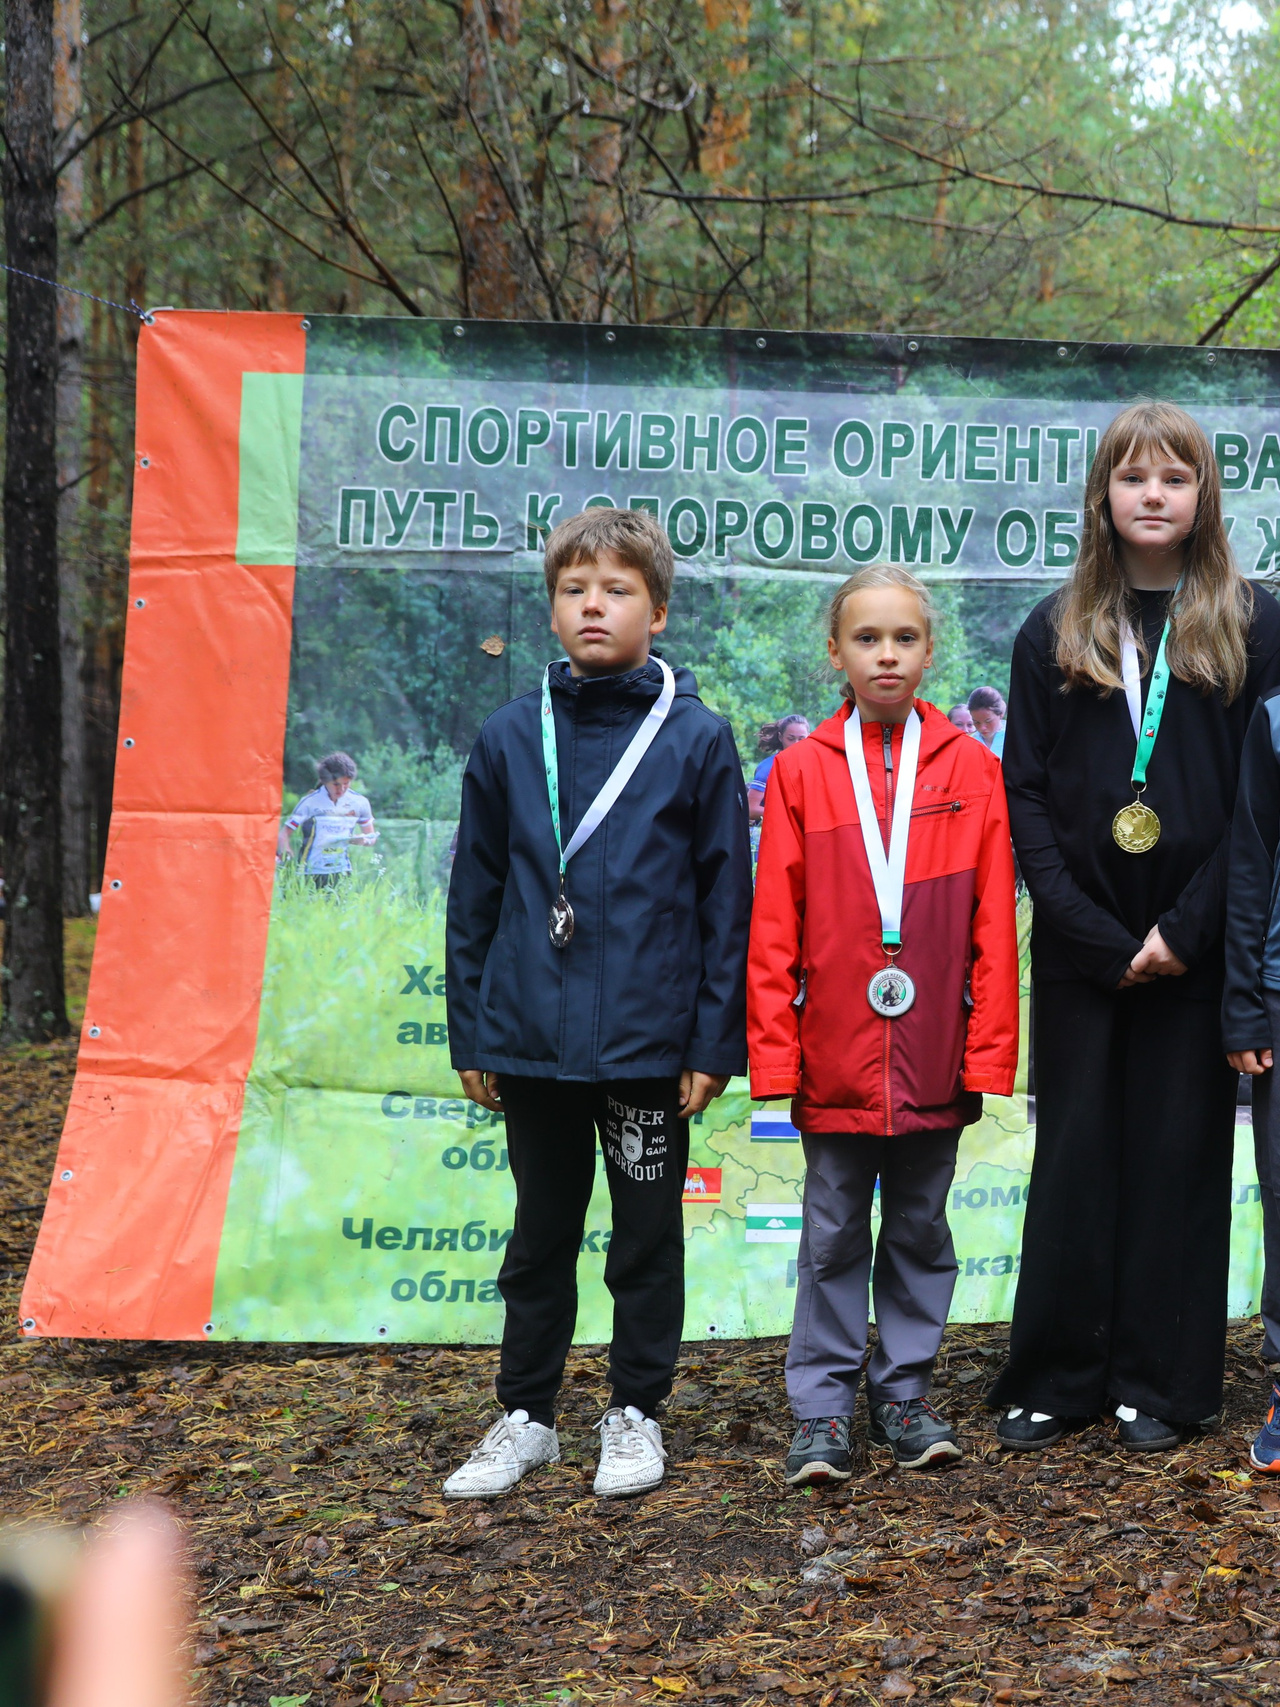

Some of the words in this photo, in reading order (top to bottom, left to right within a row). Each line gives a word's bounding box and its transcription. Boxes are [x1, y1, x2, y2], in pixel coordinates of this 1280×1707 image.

[377, 403, 808, 476] СПОРТИВНОЕ
[338, 487, 501, 550] ПУТЬ
[525, 493, 562, 552] К
[582, 493, 976, 567] ОРОВОМУ
[607, 1094, 664, 1126] POWER
[626, 1143, 635, 1153] 25
[645, 1145, 667, 1156] GAIN
[651, 1135, 666, 1144] NO
[606, 1141, 664, 1181] WORKOUT
